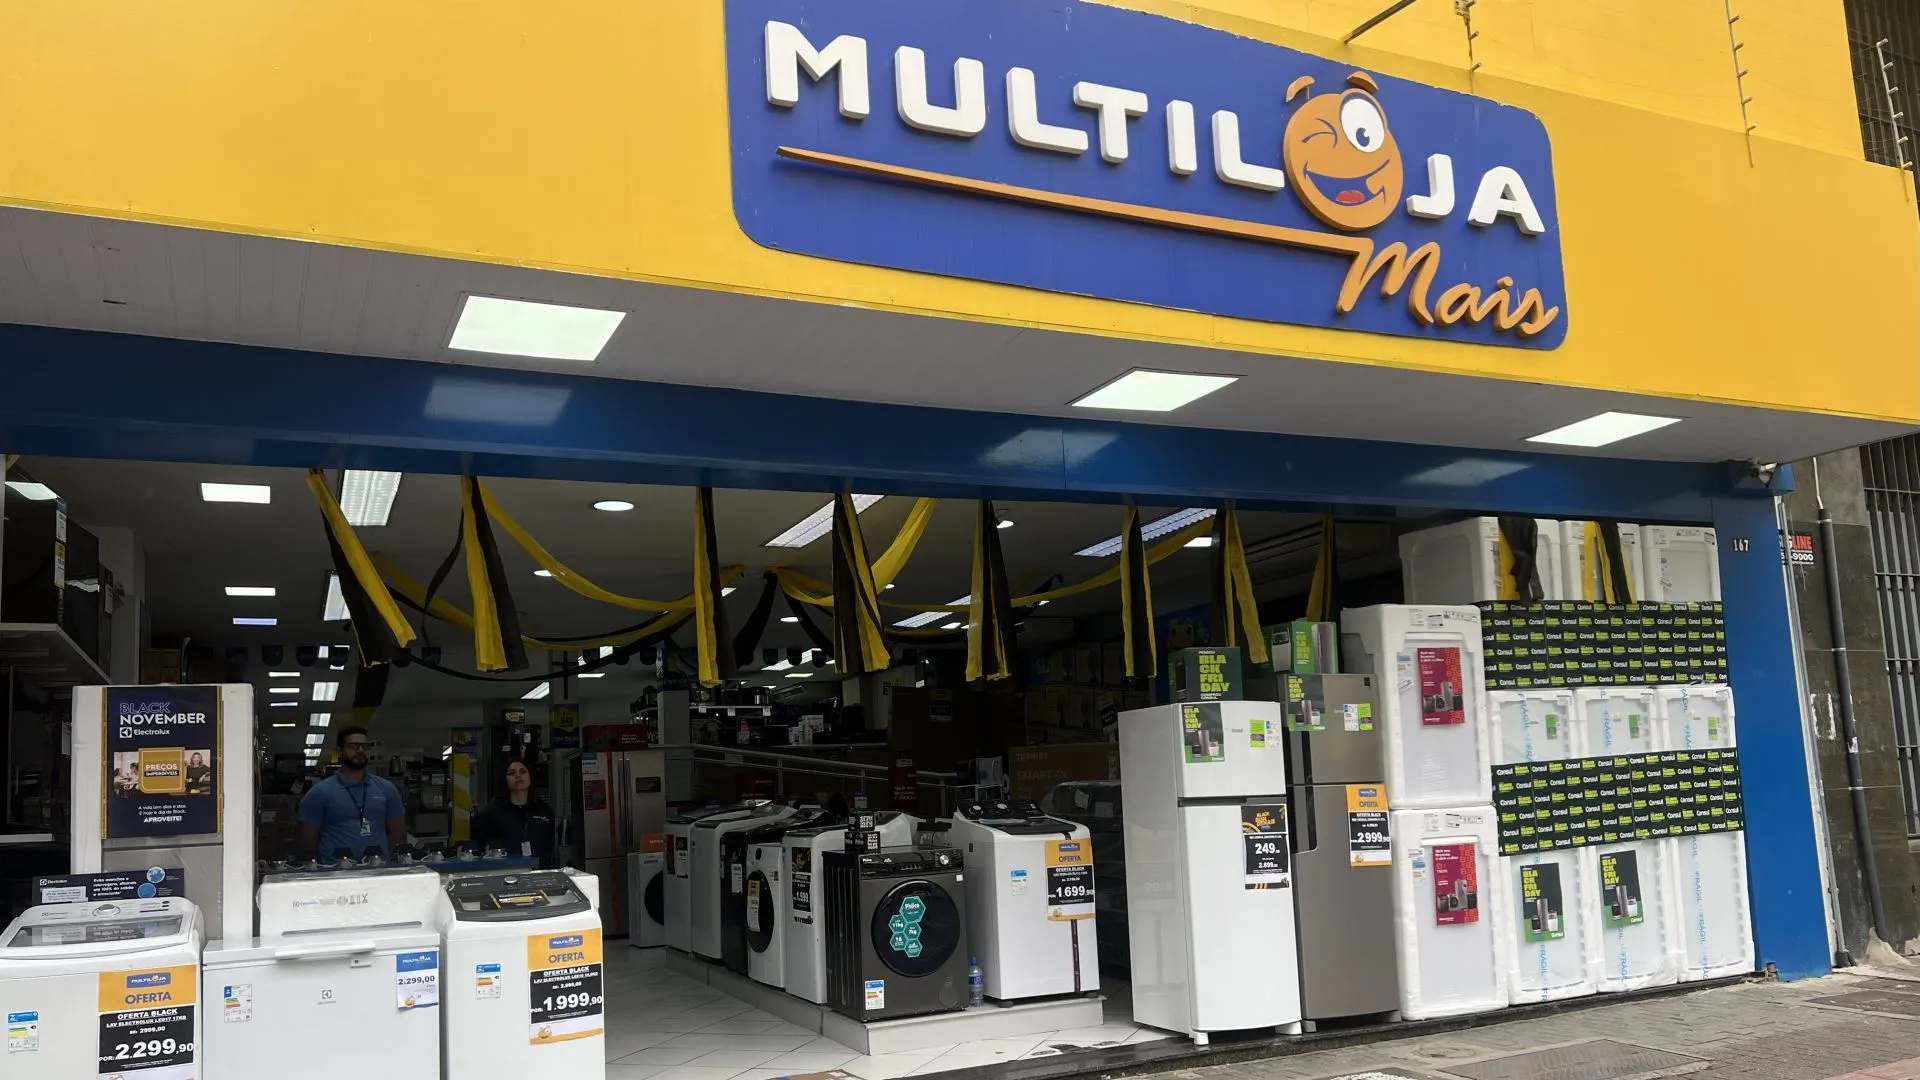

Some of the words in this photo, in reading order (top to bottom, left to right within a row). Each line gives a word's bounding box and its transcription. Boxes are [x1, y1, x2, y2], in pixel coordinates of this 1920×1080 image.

[1335, 238, 1559, 338] Mais
[1733, 539, 1749, 551] 167
[1200, 665, 1220, 673] CK
[1200, 674, 1223, 682] FRI
[1201, 683, 1230, 692] DAY
[120, 702, 171, 714] BLACK
[120, 713, 206, 725] NOVEMBER
[549, 952, 584, 963] OFERTA
[569, 966, 589, 974] BLACK
[398, 975, 435, 985] 2.299,00
[125, 992, 172, 1004] OFERTA
[543, 992, 602, 1012] 1.999,90
[118, 1011, 150, 1019] OFERTA
[151, 1008, 178, 1018] BLACK
[115, 1038, 194, 1060] 2.299,90
